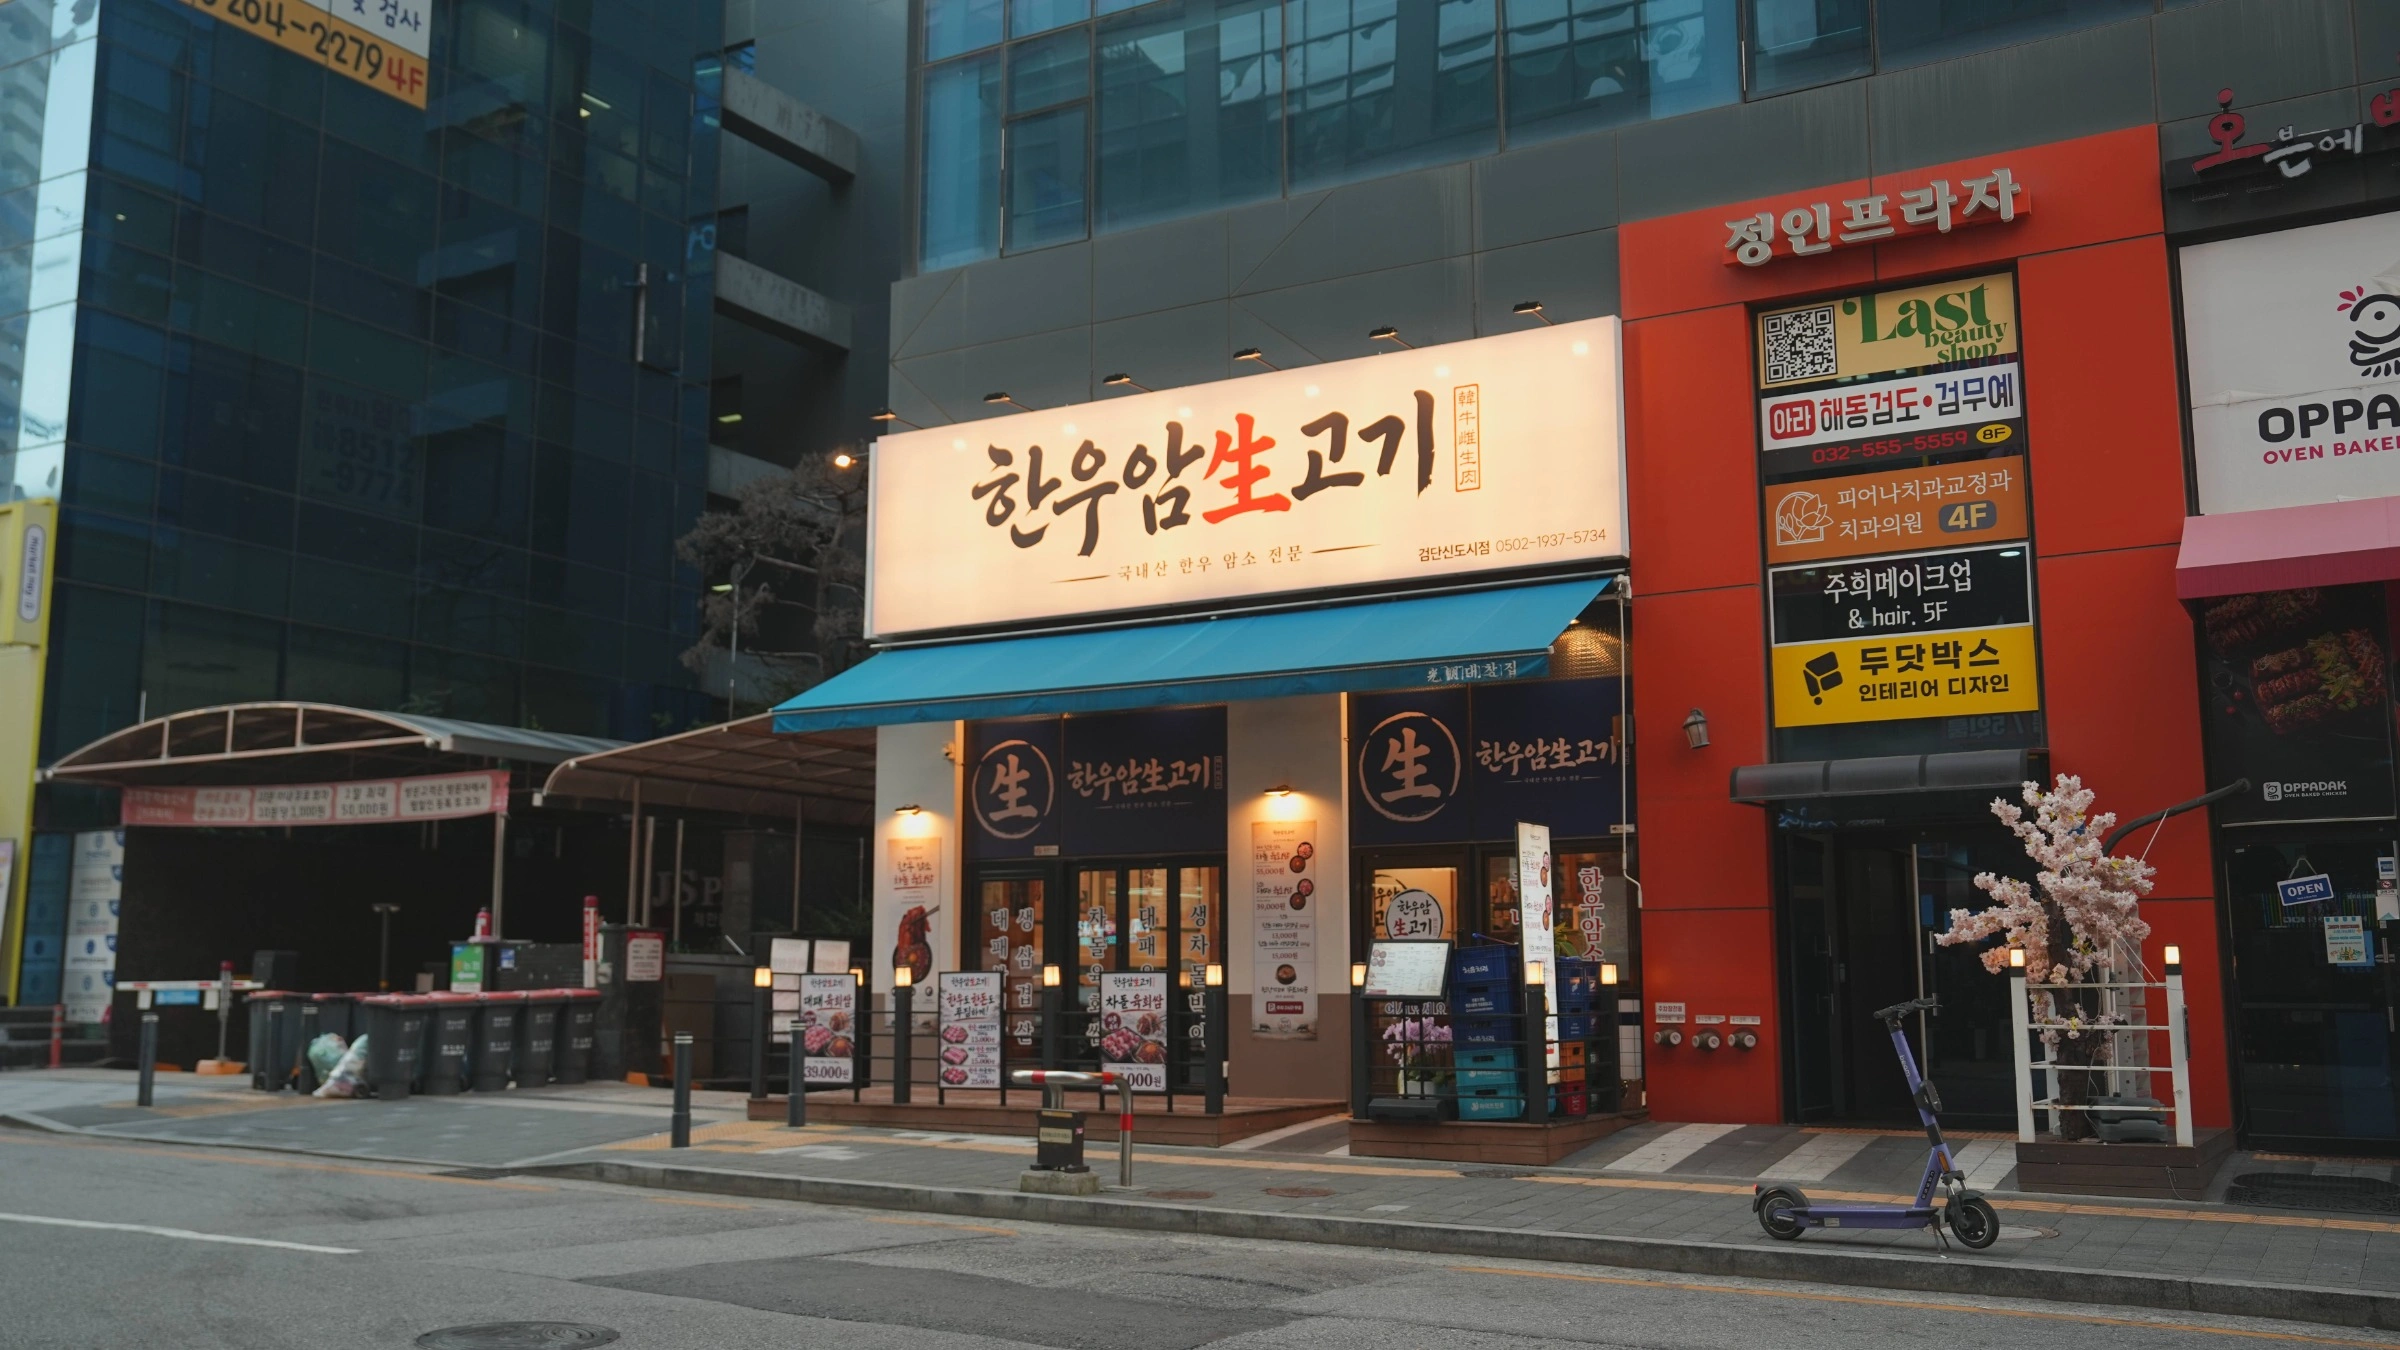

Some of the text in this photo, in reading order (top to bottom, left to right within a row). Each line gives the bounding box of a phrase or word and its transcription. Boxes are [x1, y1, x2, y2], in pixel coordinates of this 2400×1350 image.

[387, 56, 424, 95] 4F
[1725, 167, 2021, 267] 정인프라자
[1842, 283, 1992, 344] Last
[1925, 320, 2009, 348] beauty
[1937, 341, 1998, 365] shop
[1773, 406, 1812, 435] 아라
[1812, 427, 2006, 464] 032-555-5559 8F
[2263, 434, 2400, 465] OVEN BAKE
[972, 389, 1435, 557] 한우암生고기
[1837, 469, 2012, 508] 피어나치과교정과
[1839, 505, 1987, 541] 치과의원 4F
[1117, 544, 1304, 582] 국내산 한우 암소 전문
[1418, 527, 1607, 563] 검단신도시점 0502-1937-5734
[1824, 559, 1972, 604] 주희메이크업
[1848, 608, 1865, 629] &
[1924, 601, 1948, 623] 5F
[1859, 638, 2000, 676] 두닷박스
[1858, 673, 2010, 702] 인테리어 디자인
[1380, 726, 1442, 803] 生
[1475, 735, 1618, 776] 한우암生고기
[988, 753, 1039, 822] 生
[1067, 755, 1211, 802] 한우암生고기
[2283, 780, 2347, 793] OPPADAK
[2287, 882, 2324, 897] OPEN
[1397, 899, 1432, 917] 한우암
[1393, 918, 1433, 937] 生고기
[946, 992, 995, 1007] 한우도 한돈도
[1105, 993, 1164, 1010] 차돌 육회쌈
[1899, 1054, 1911, 1078] beam
